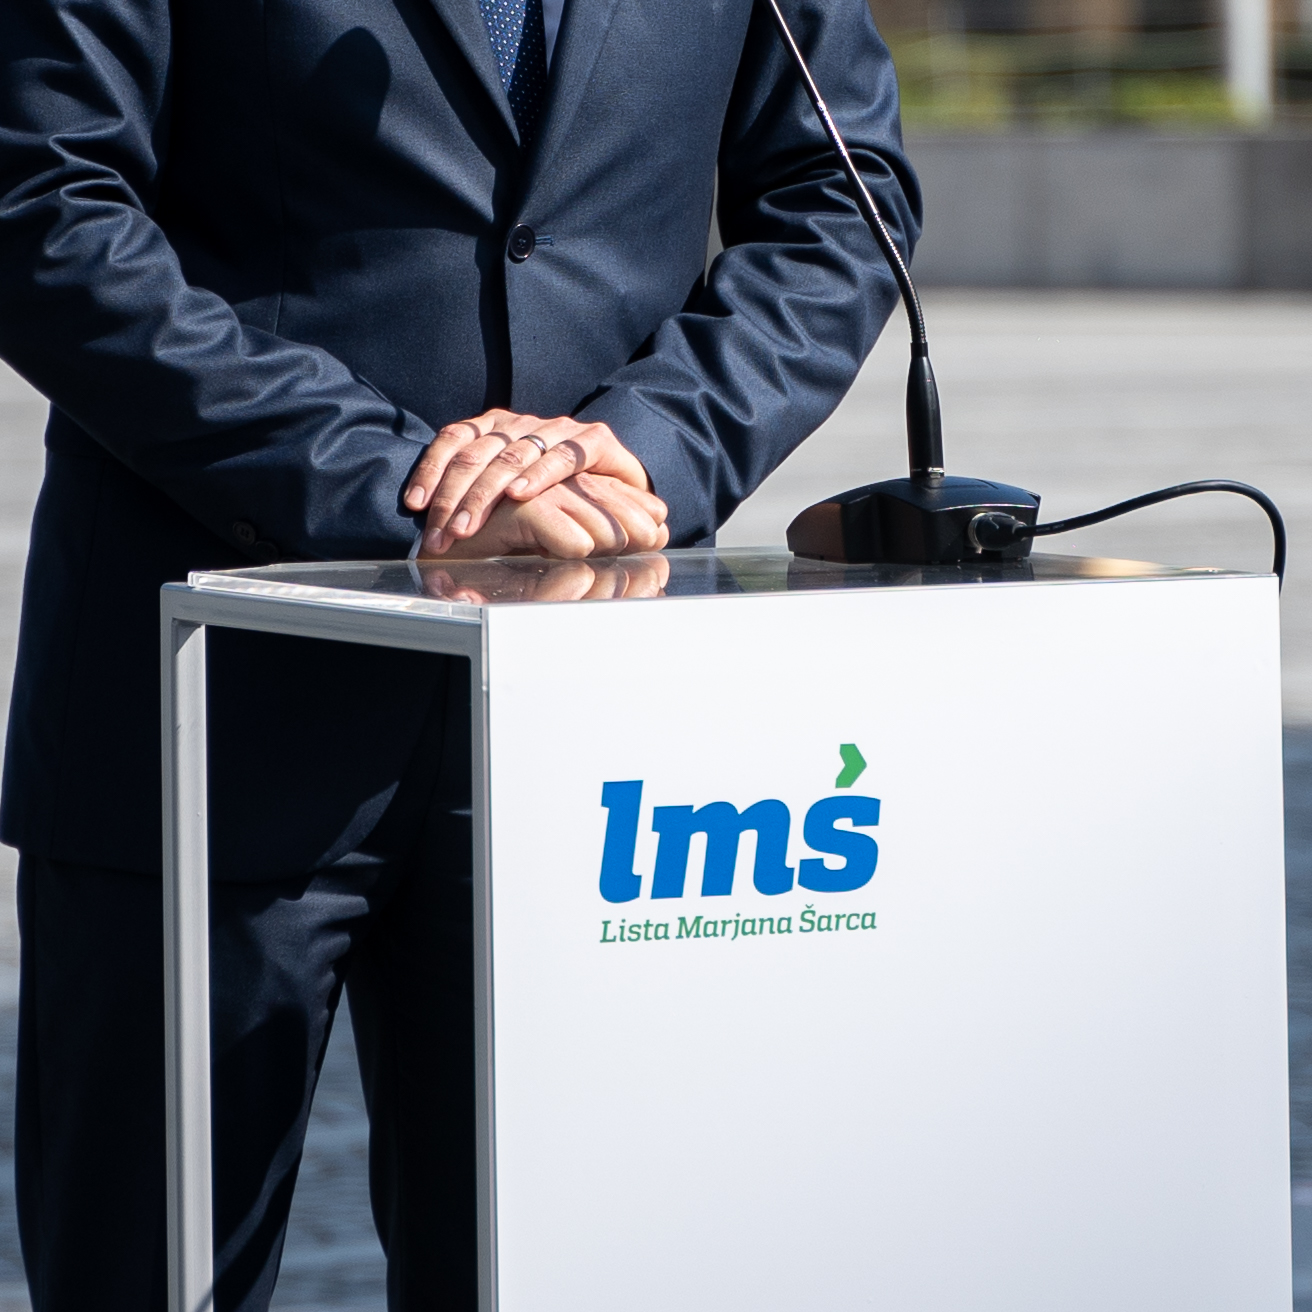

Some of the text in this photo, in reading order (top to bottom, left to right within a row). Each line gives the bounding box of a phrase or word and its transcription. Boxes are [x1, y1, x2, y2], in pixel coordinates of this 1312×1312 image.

[599, 903, 877, 943] Lista Marjana Šarca
